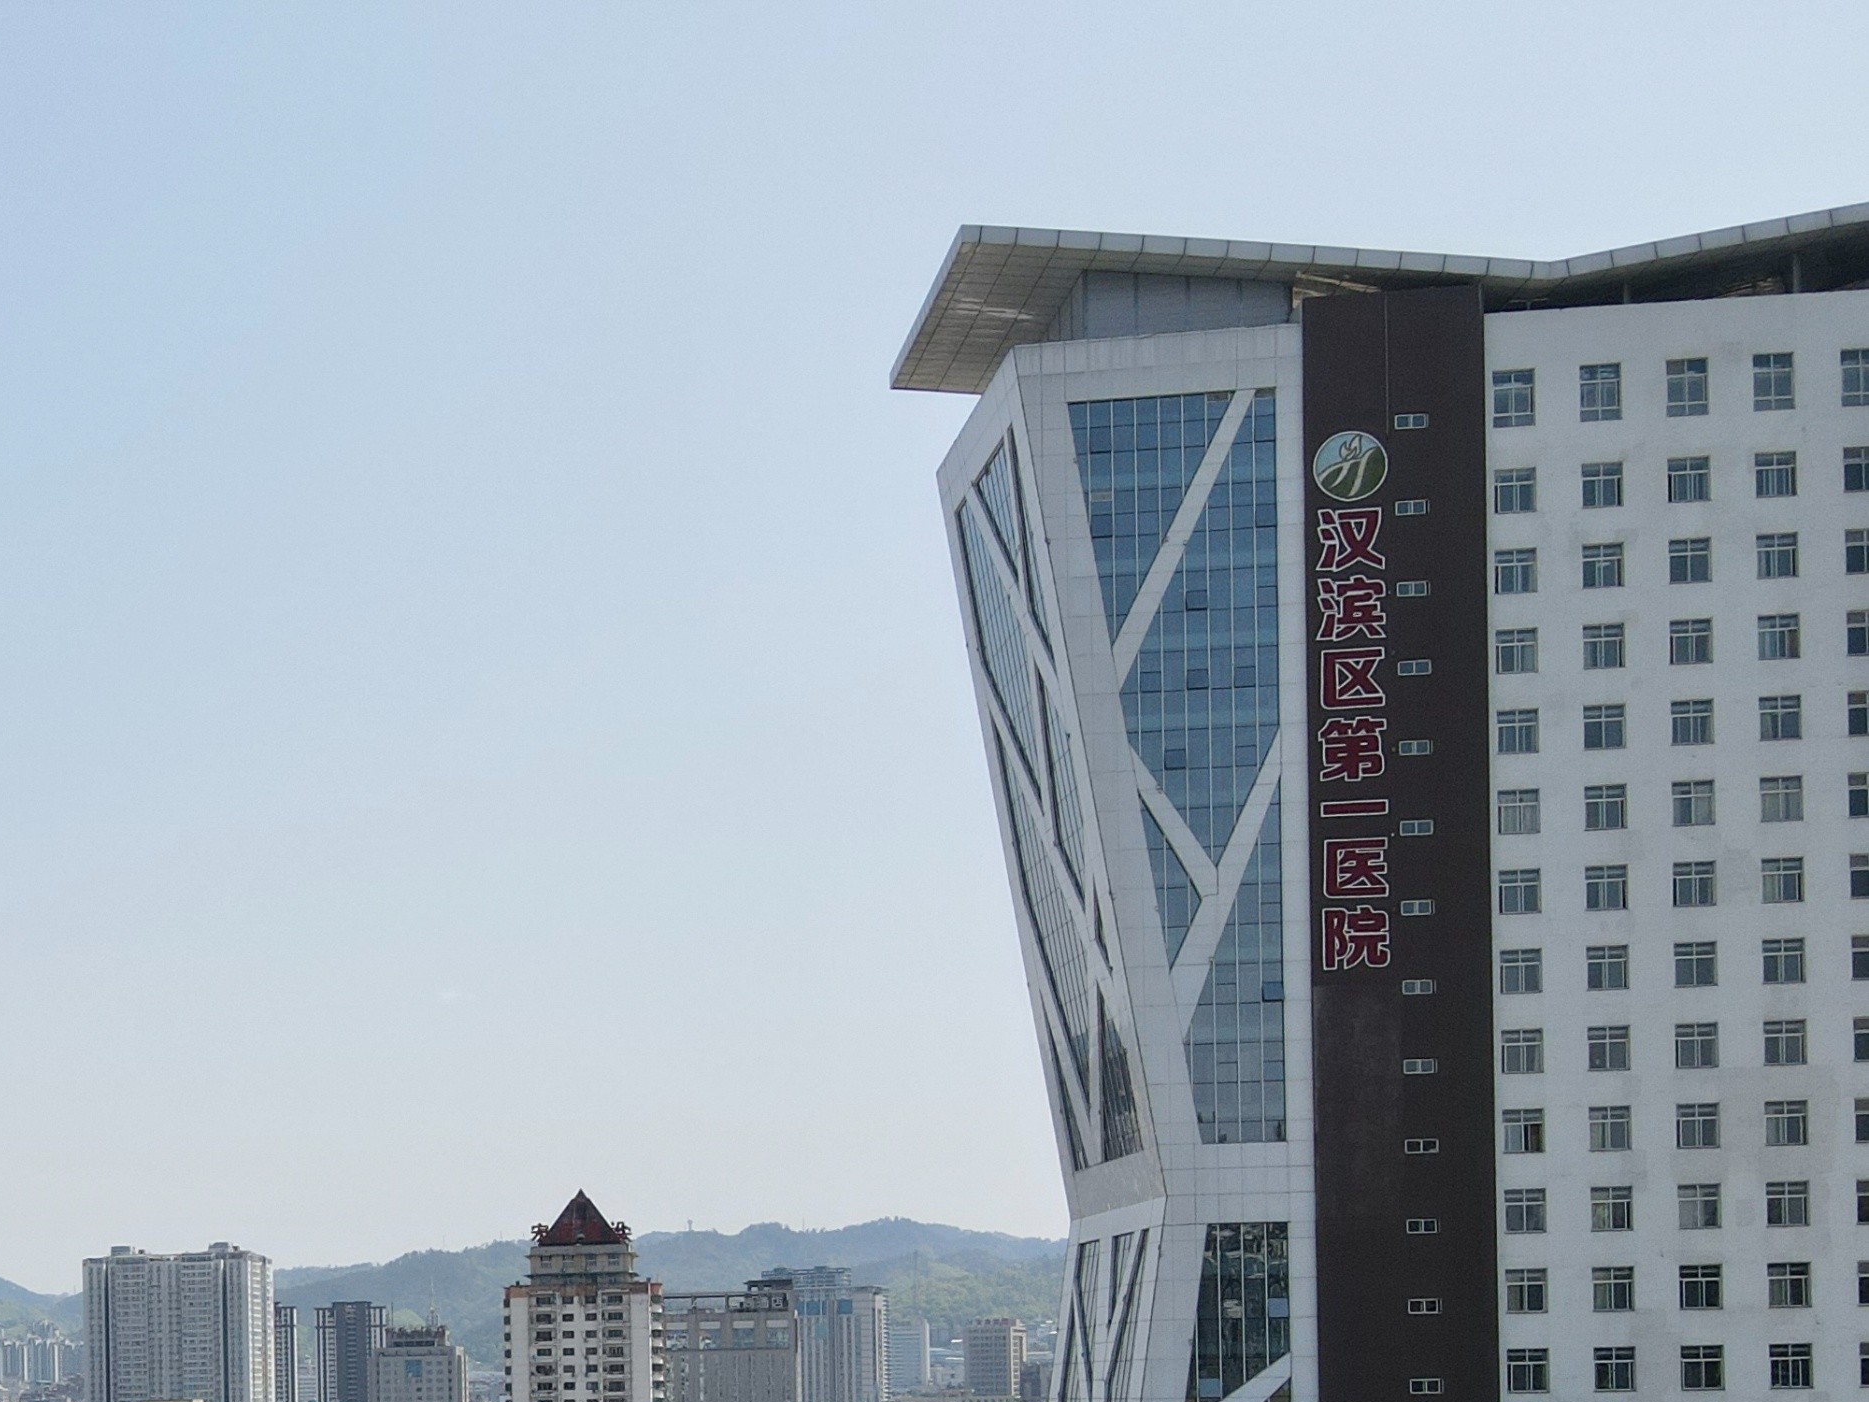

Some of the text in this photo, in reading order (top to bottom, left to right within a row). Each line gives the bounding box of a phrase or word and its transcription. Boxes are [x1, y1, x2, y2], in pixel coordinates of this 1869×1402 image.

[1316, 507, 1392, 971] 汉滨区第一医院
